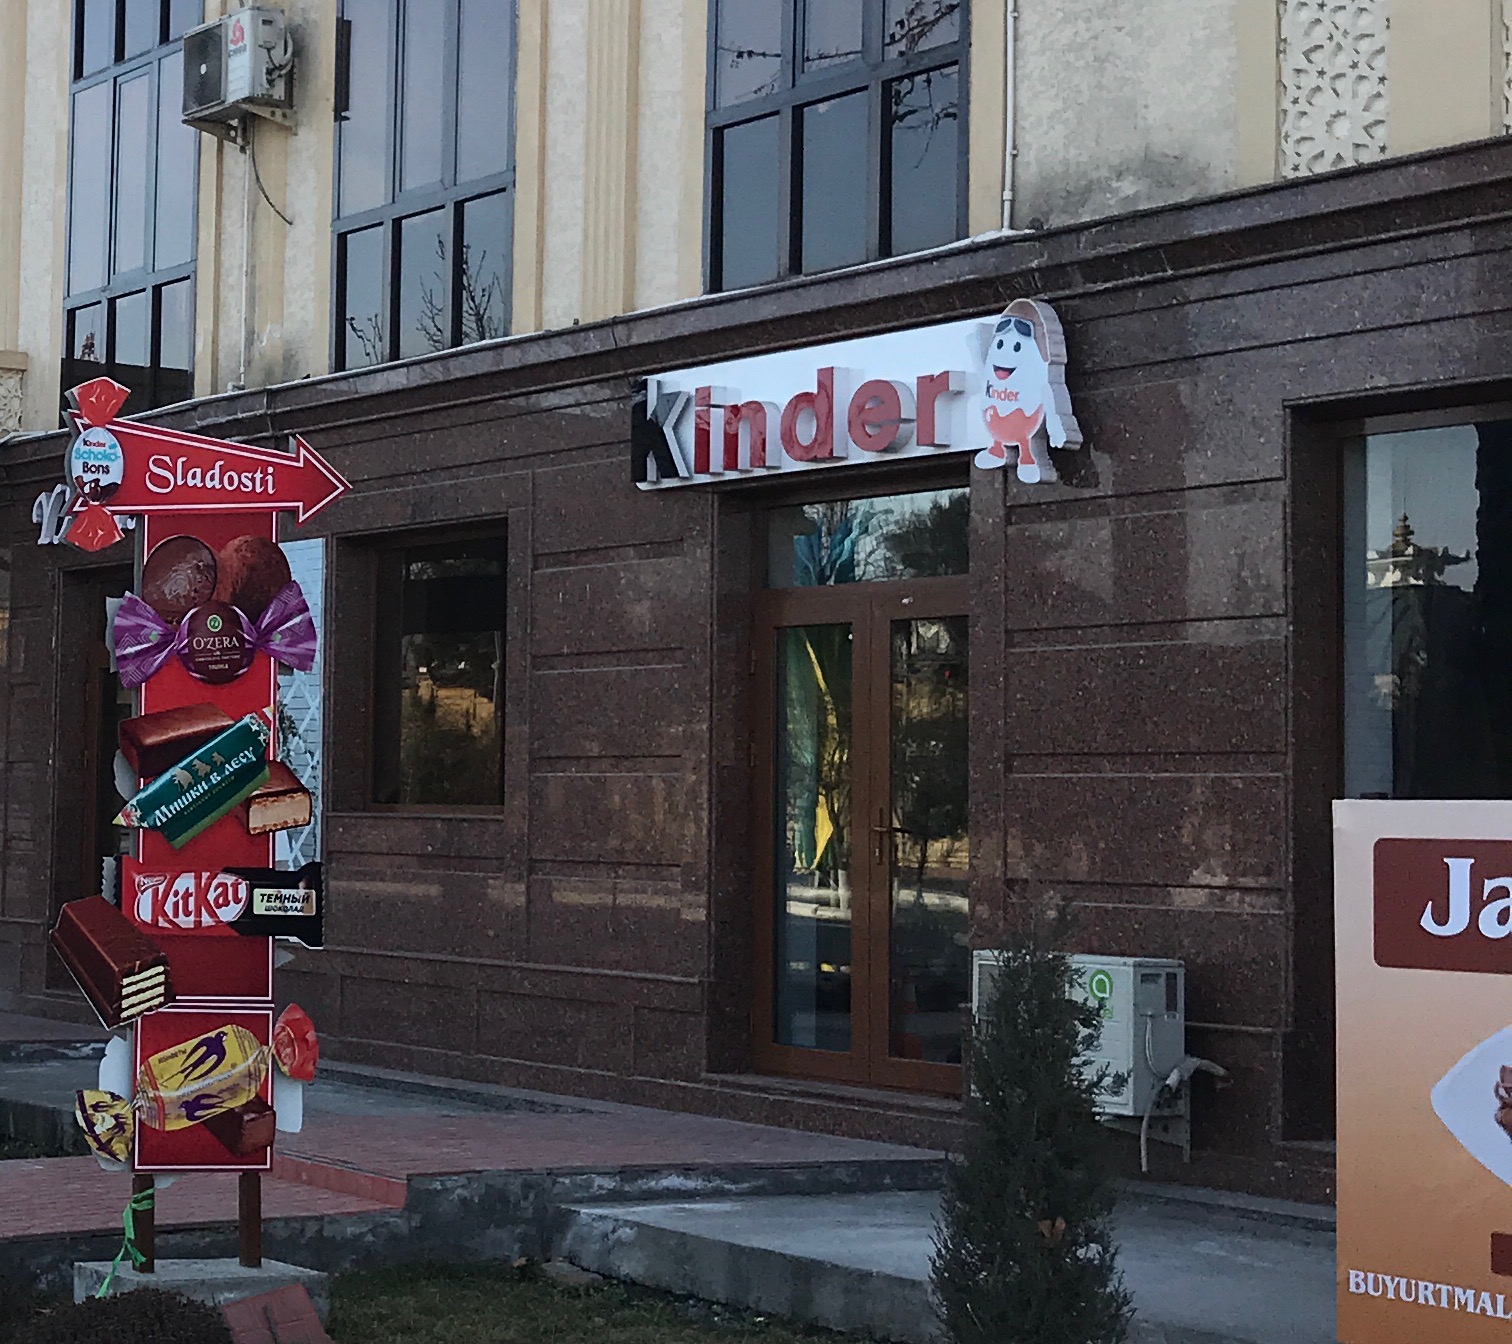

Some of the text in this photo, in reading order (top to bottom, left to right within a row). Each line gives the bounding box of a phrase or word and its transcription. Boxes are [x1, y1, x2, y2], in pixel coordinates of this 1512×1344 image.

[82, 461, 111, 475] Bons
[145, 455, 277, 494] Sladosti
[151, 871, 244, 929] KitKat
[259, 892, 310, 905] ТЕМНЫЙ
[1348, 1268, 1512, 1320] BUYURTMAL
